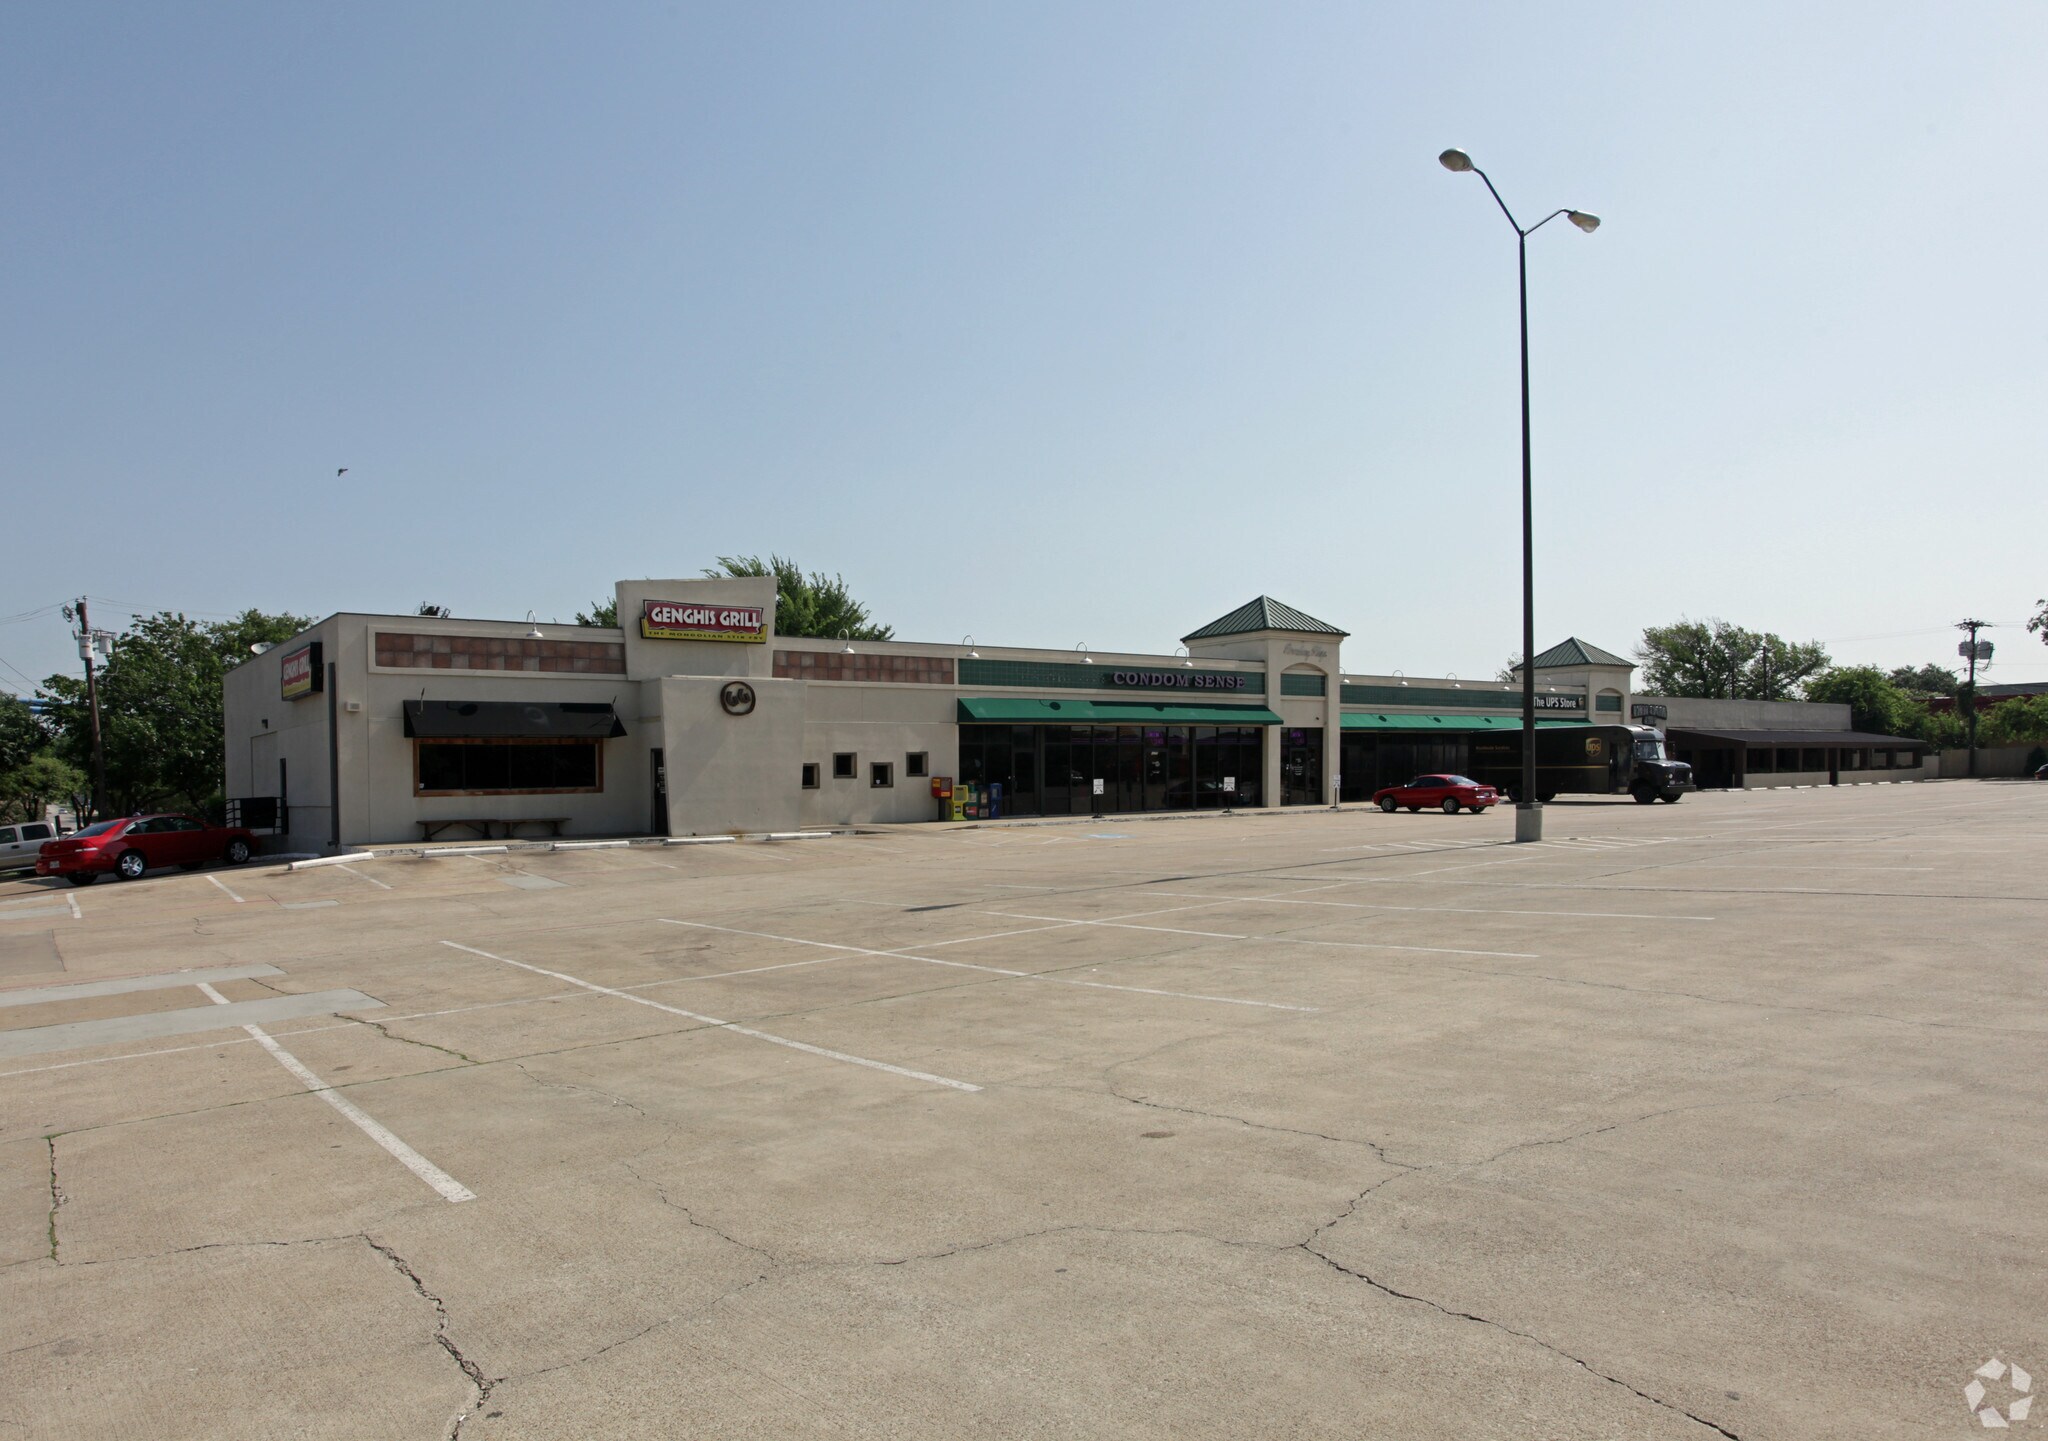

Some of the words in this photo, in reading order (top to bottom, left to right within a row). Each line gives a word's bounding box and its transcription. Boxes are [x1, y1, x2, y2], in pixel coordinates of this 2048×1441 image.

[651, 606, 716, 625] GENGHIS
[720, 611, 760, 627] GRILL
[1113, 671, 1190, 687] CONDOM
[1195, 675, 1245, 689] SENSE
[1546, 696, 1559, 708] UPS
[1560, 697, 1577, 708] Store
